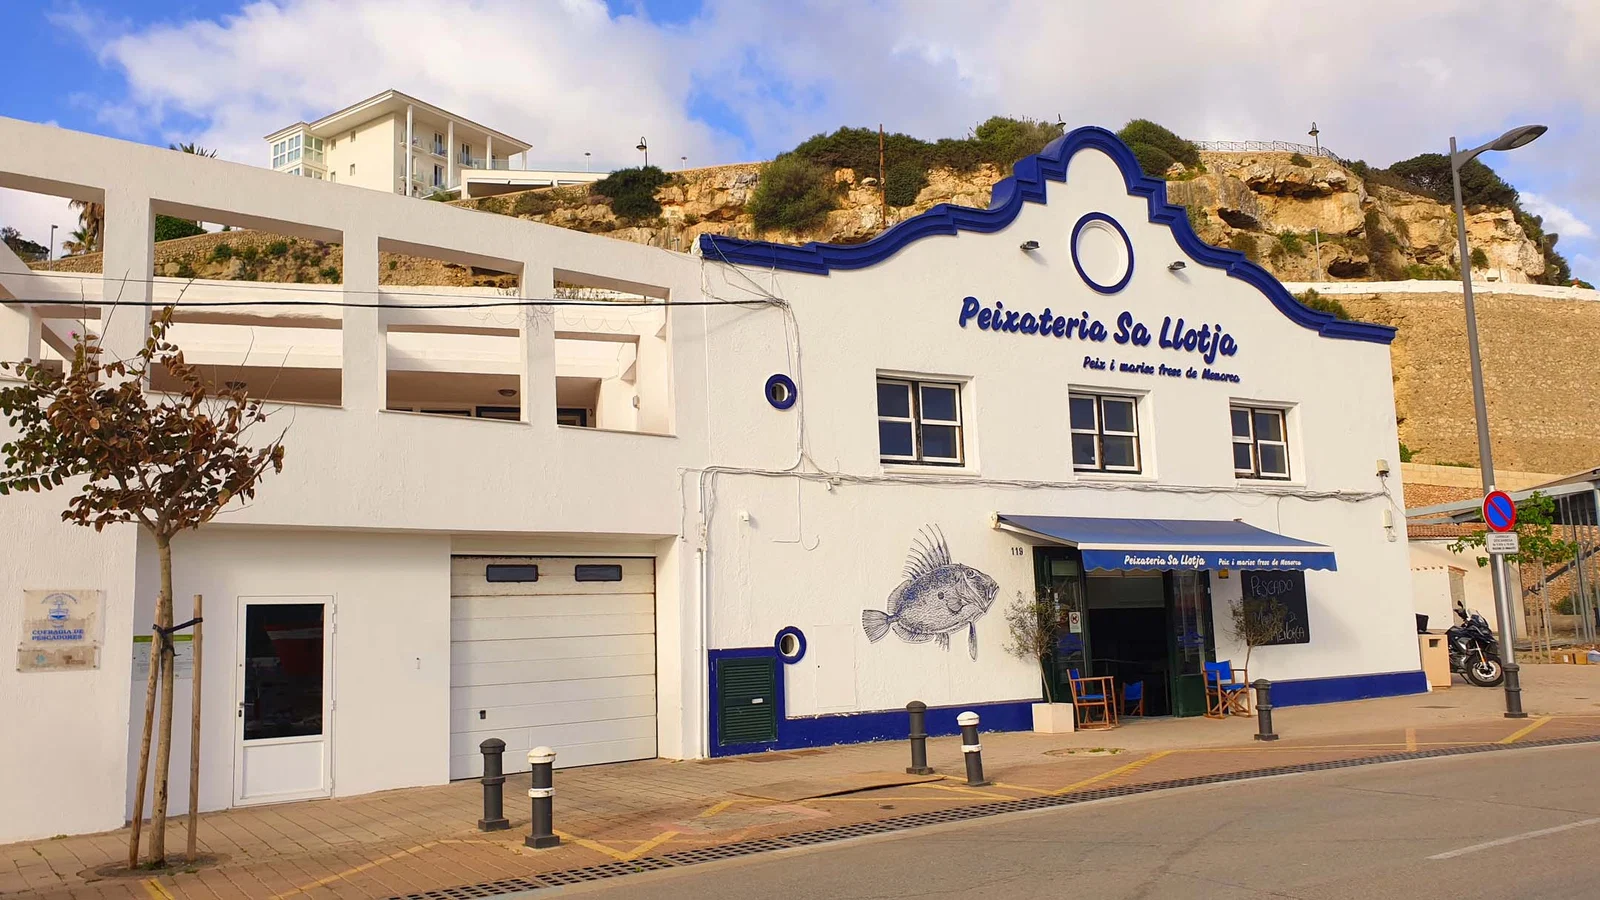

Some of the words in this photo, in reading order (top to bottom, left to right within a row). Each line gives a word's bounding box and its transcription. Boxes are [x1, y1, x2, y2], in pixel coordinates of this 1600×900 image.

[958, 296, 1107, 344] Peixateria
[1113, 311, 1151, 346] Sa
[1158, 316, 1237, 364] Llotja
[1083, 355, 1106, 370] Peix
[1109, 359, 1115, 371] i
[1185, 367, 1197, 379] de
[1201, 368, 1240, 383] Menorca
[1011, 547, 1023, 556] 119
[1124, 554, 1166, 565] Peixateria
[1167, 554, 1179, 566] Sa
[1180, 554, 1206, 569] Llotja
